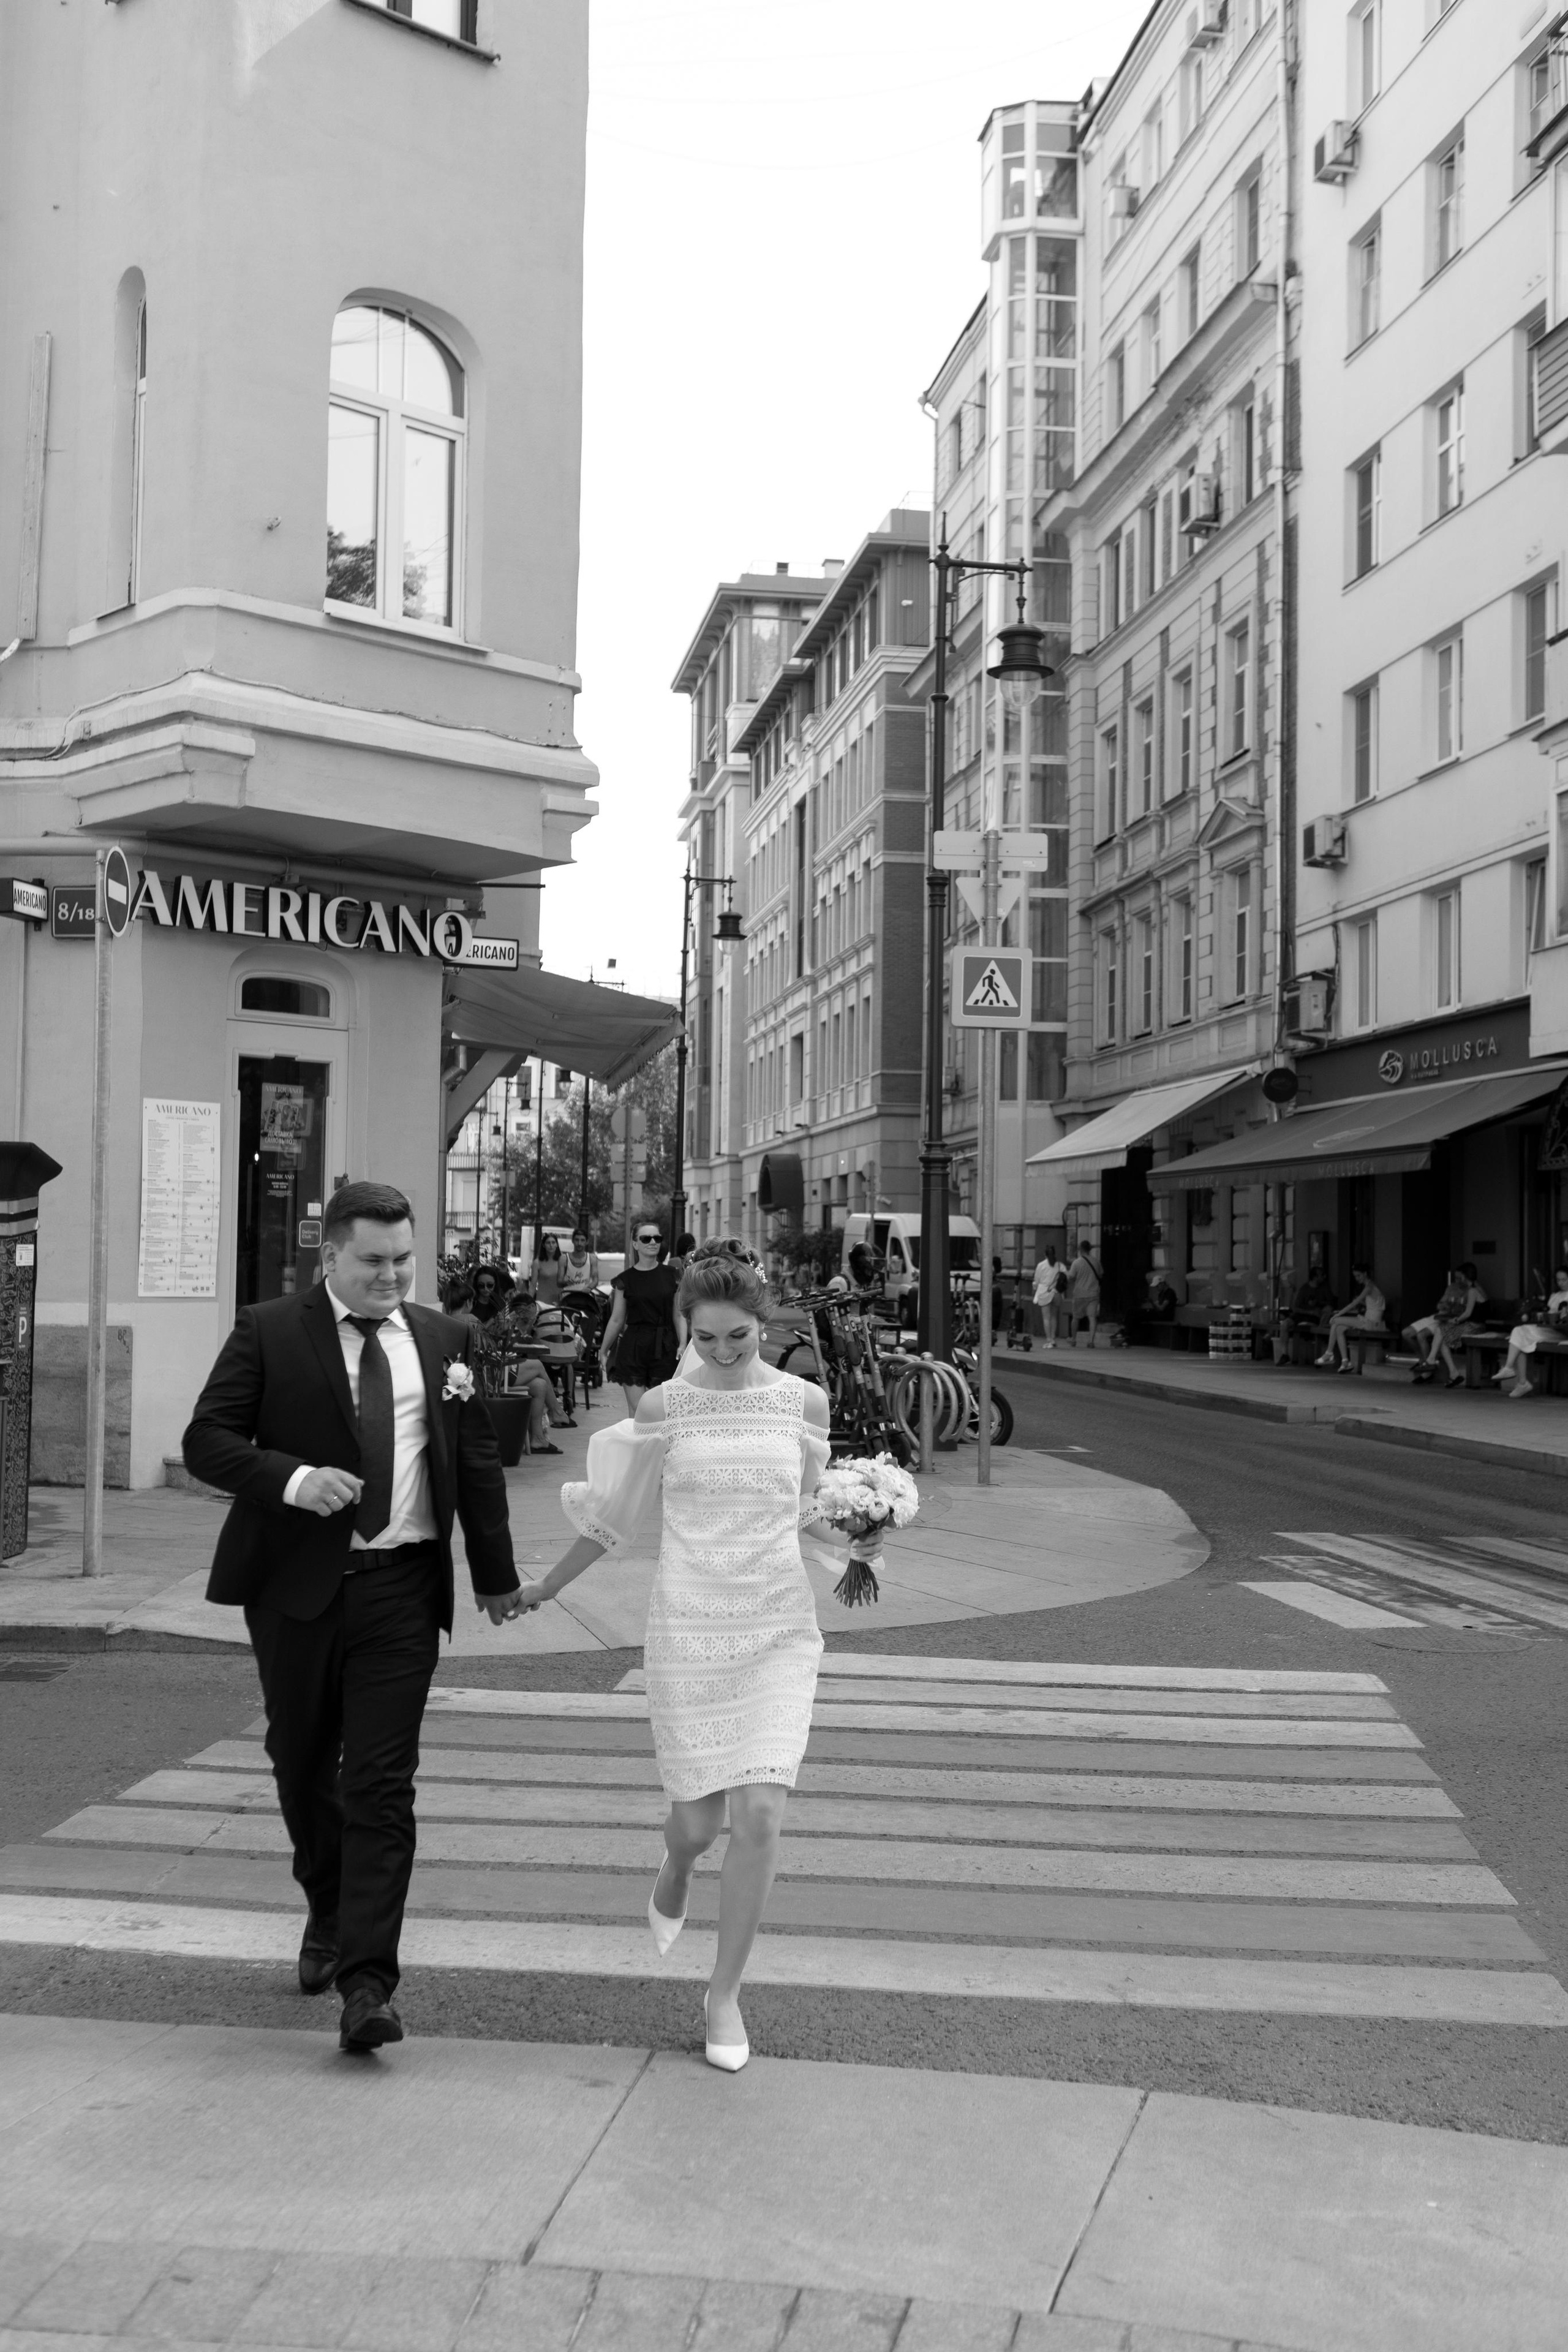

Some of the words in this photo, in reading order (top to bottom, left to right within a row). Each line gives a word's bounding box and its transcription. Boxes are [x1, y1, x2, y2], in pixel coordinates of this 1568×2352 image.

[14, 888, 46, 911] AMERICANO
[58, 902, 95, 922] 8/18
[130, 870, 473, 961] AMERICANO
[447, 943, 514, 960] ARICANO
[1410, 1036, 1498, 1069] MOLLUSCA
[155, 1104, 211, 1115] AMERICANO
